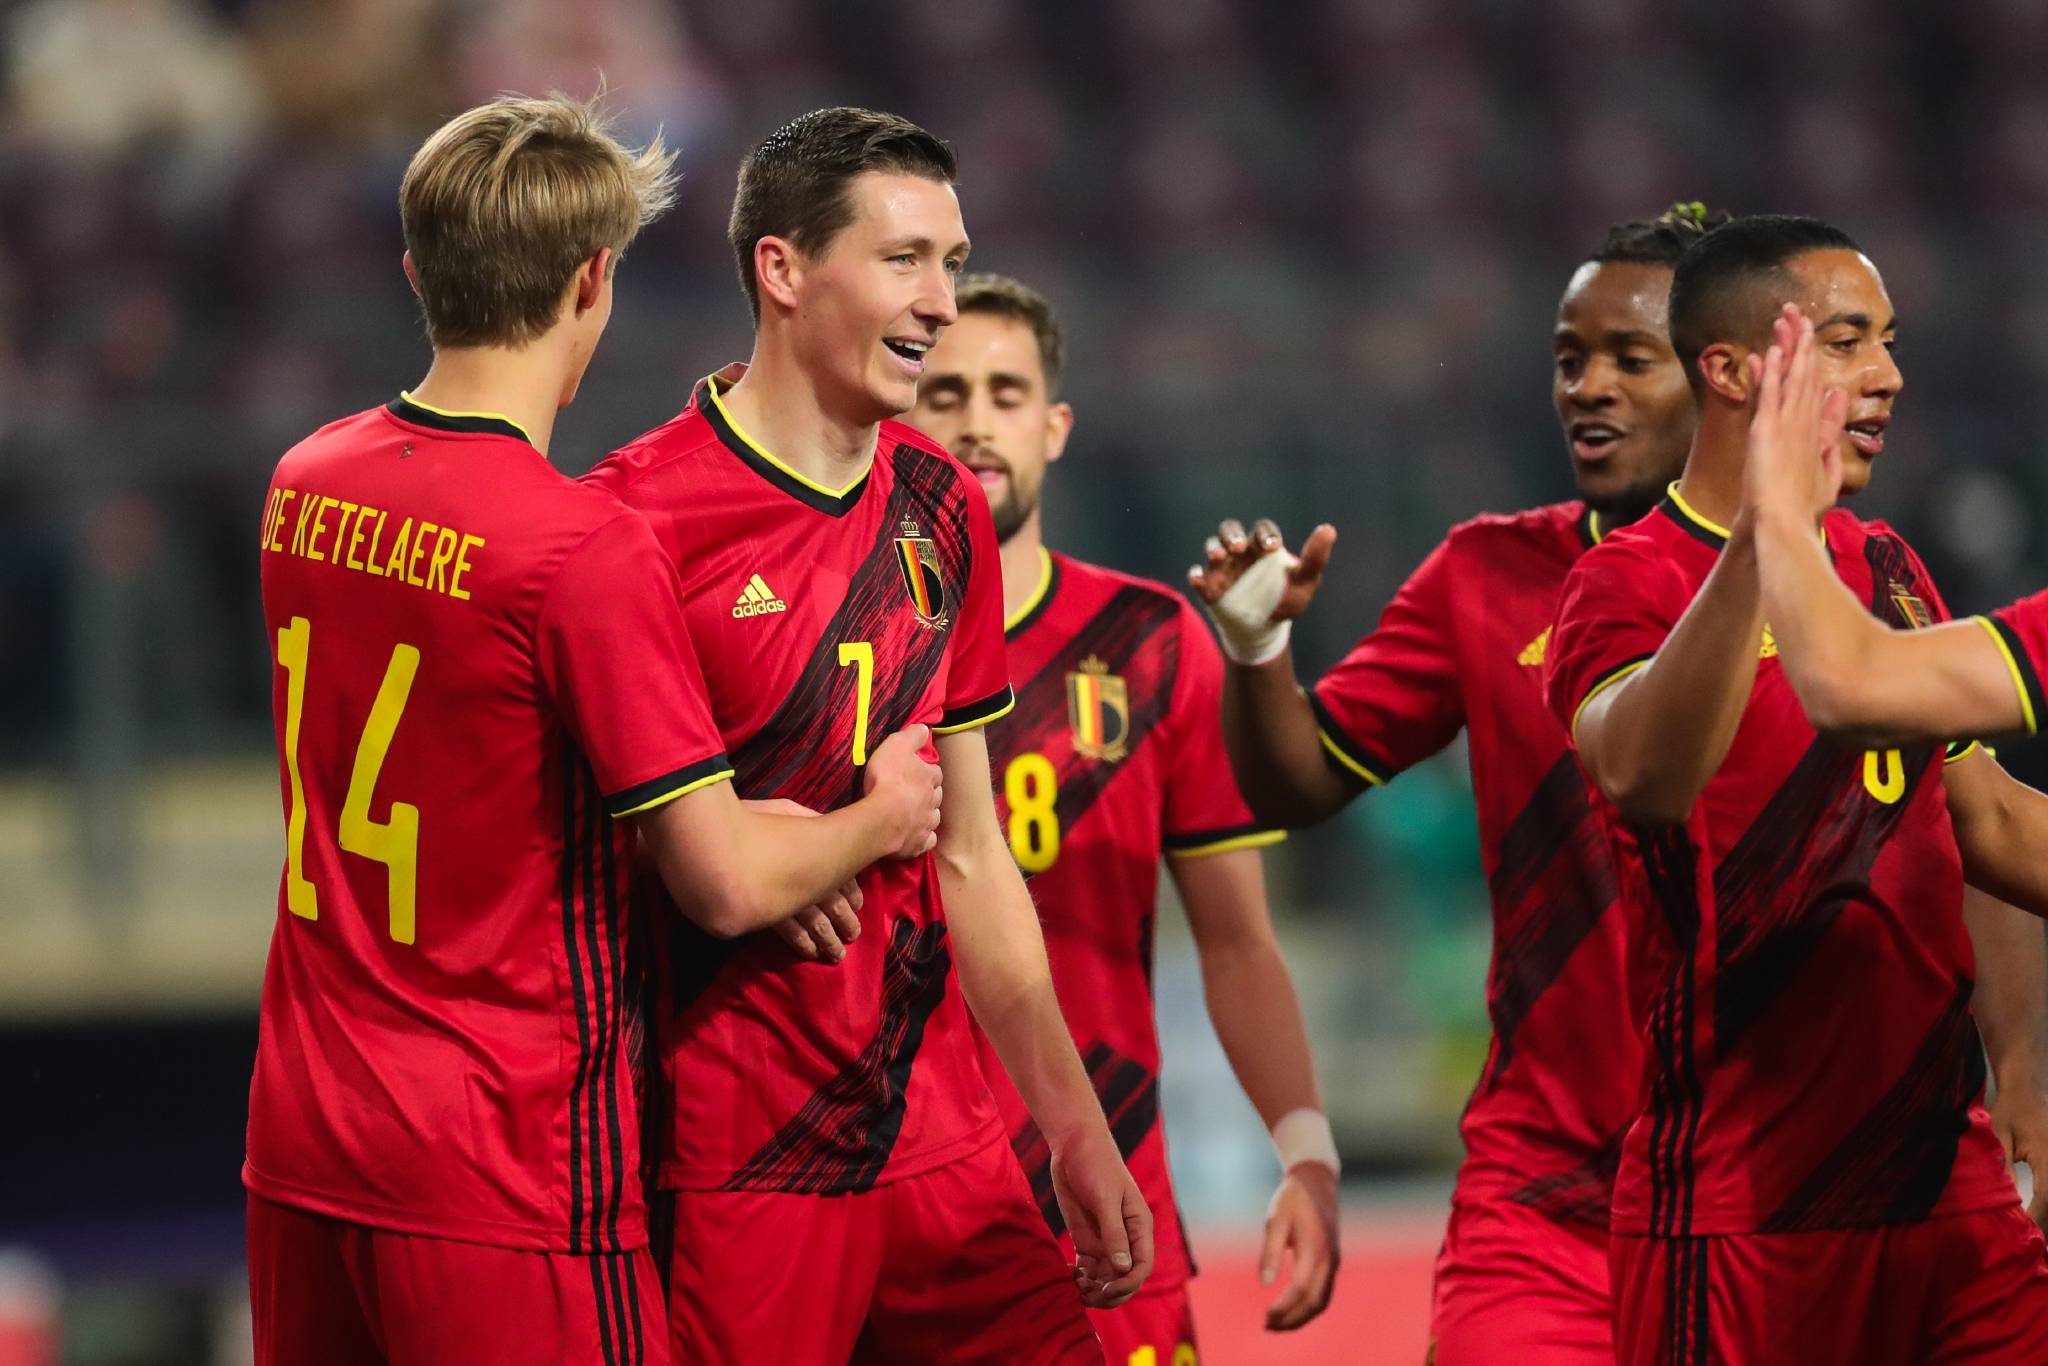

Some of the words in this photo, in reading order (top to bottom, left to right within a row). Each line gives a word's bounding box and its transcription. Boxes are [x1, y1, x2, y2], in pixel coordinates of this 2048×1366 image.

[262, 488, 297, 553] DE
[291, 492, 486, 601] KETELAERE
[732, 599, 787, 619] adidas
[838, 641, 874, 766] 7
[278, 616, 421, 945] 14
